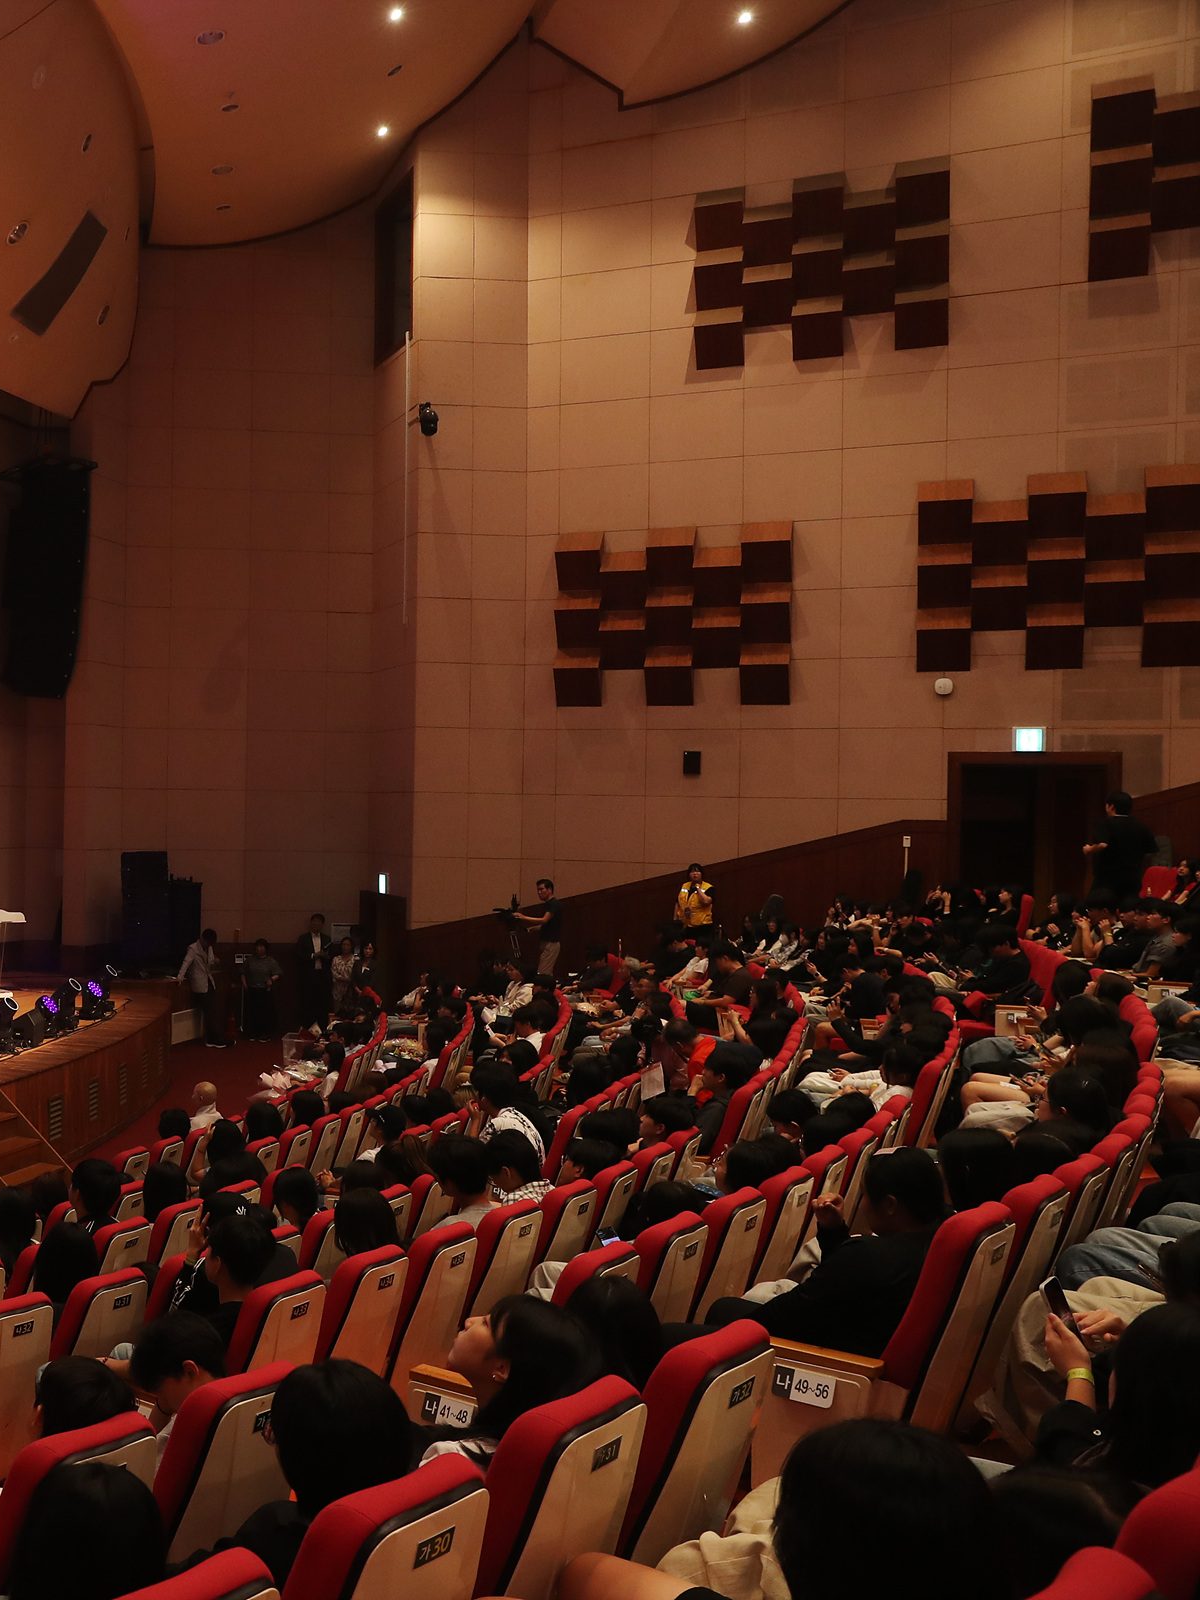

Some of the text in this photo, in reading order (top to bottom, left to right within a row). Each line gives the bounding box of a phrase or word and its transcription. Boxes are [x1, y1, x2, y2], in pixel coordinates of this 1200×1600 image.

[732, 1383, 751, 1402] 가32
[776, 1373, 830, 1399] 나 49~56
[425, 1400, 468, 1424] 나 41~48
[419, 1533, 451, 1560] 가30
